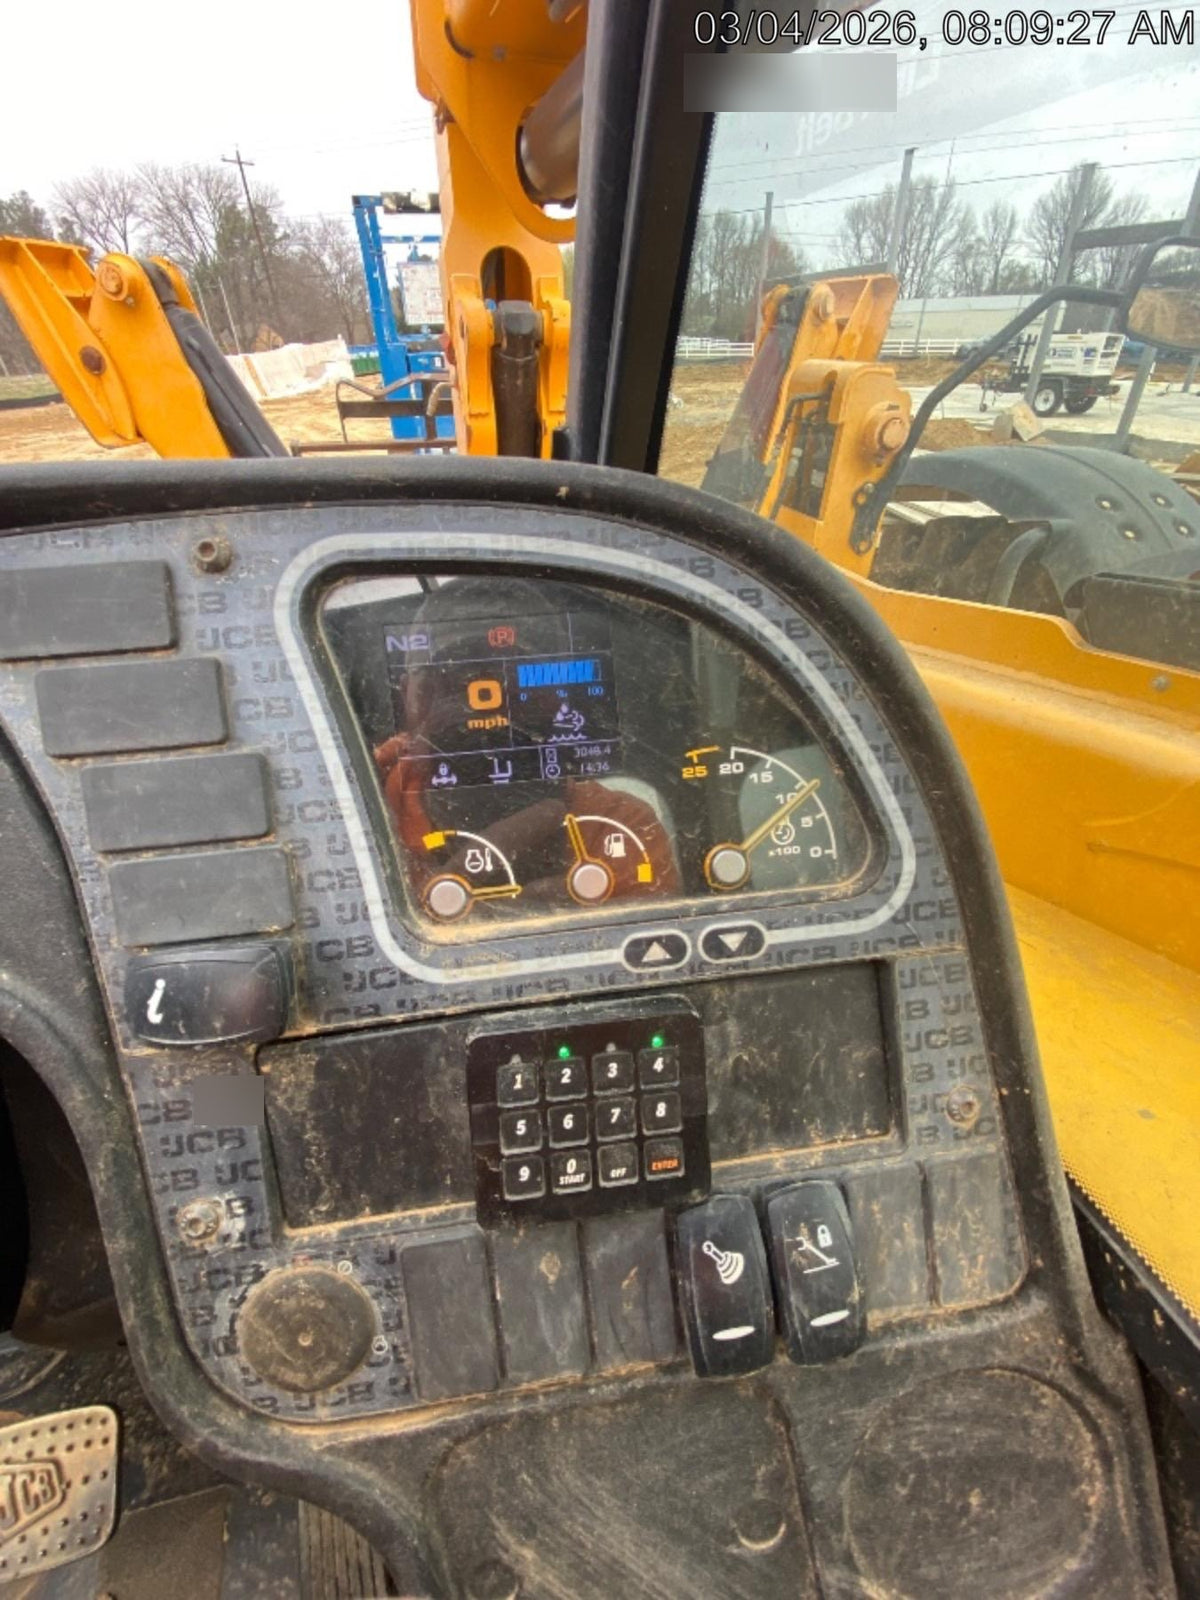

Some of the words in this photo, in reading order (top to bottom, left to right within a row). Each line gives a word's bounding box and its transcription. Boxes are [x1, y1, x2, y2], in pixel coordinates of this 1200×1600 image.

[386, 634, 429, 652] N2
[467, 680, 502, 710] 0
[587, 685, 604, 697] 100
[467, 715, 510, 730] mph
[681, 765, 708, 780] 25
[718, 762, 745, 775] 20
[749, 771, 774, 784] 15
[800, 815, 813, 828] 5
[809, 846, 823, 858] 0
[899, 962, 967, 989] JCB
[904, 1024, 974, 1053] JCB
[513, 1073, 523, 1090] 1
[560, 1067, 572, 1084] 2
[607, 1062, 618, 1078] 3
[653, 1057, 664, 1073] 4
[515, 1119, 527, 1136] 5
[563, 1113, 574, 1130] 6
[610, 1107, 621, 1124] 7
[655, 1101, 667, 1118] 8
[160, 1127, 248, 1158] JCB
[518, 1166, 530, 1182] 9
[566, 1158, 577, 1174] 0
[609, 1167, 627, 1178] OFF
[651, 1158, 679, 1171] ENTER
[559, 1173, 586, 1185] START
